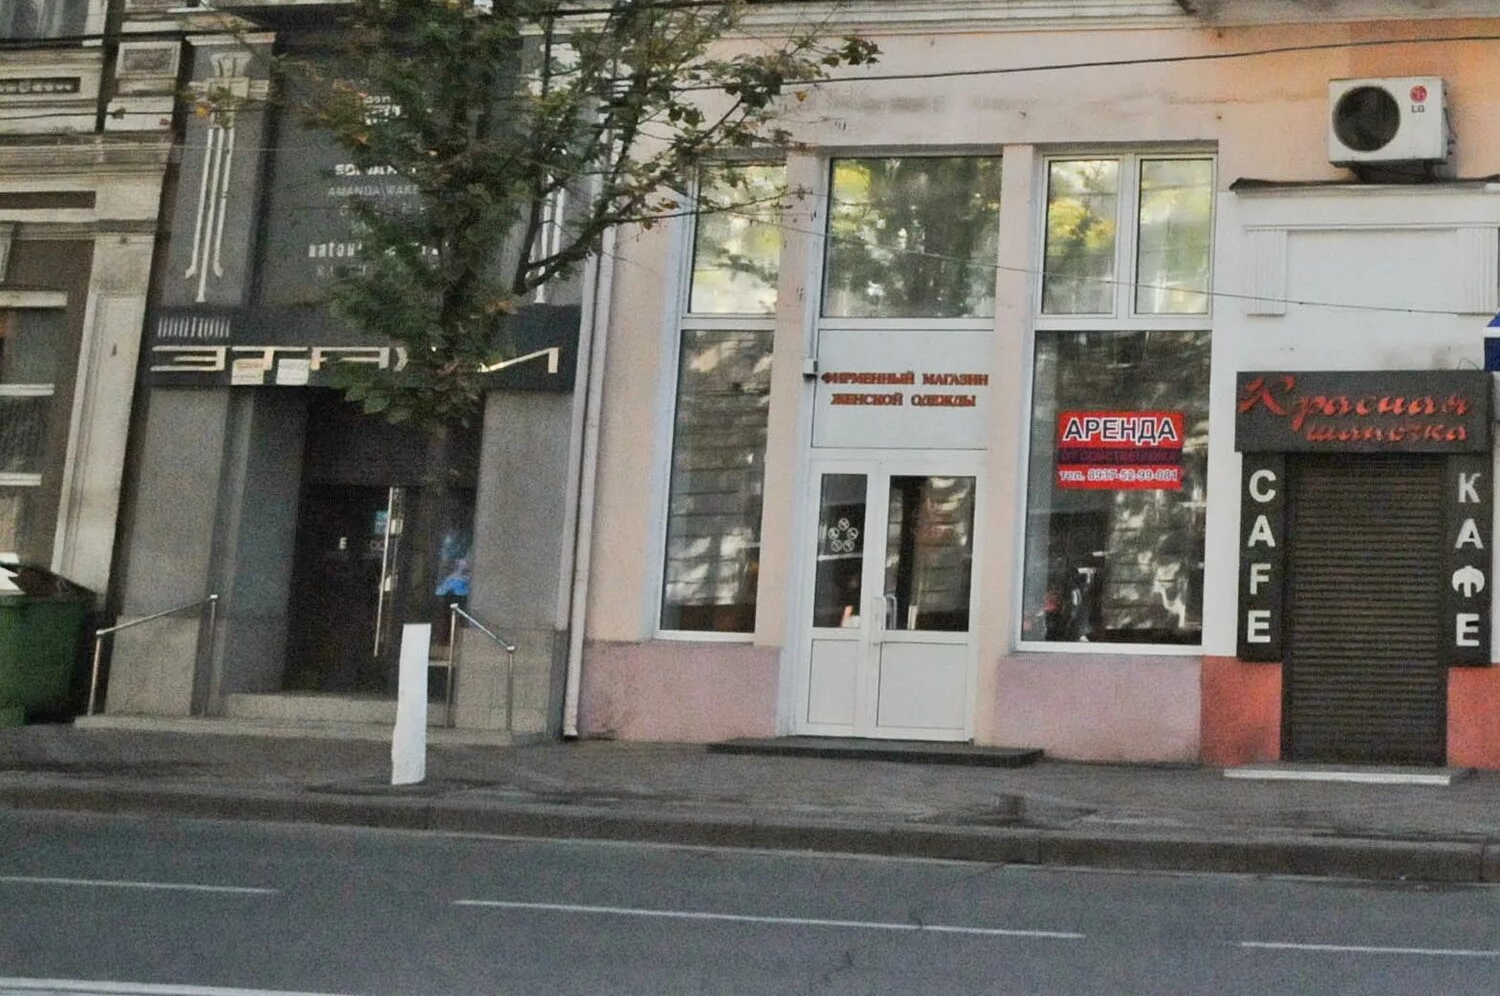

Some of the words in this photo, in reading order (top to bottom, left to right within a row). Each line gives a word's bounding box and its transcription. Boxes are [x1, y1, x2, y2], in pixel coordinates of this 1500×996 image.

[1411, 105, 1425, 113] LG
[821, 371, 915, 385] ФИРМЕННЫЙ
[922, 374, 988, 386] МАГАЗИН
[830, 392, 903, 406] ЖЕНСКОЙ
[911, 394, 976, 407] ОДЕЖДЫ
[1238, 375, 1469, 431] Красная
[1062, 417, 1178, 446] АРЕНДА
[1248, 469, 1277, 643] CAFE
